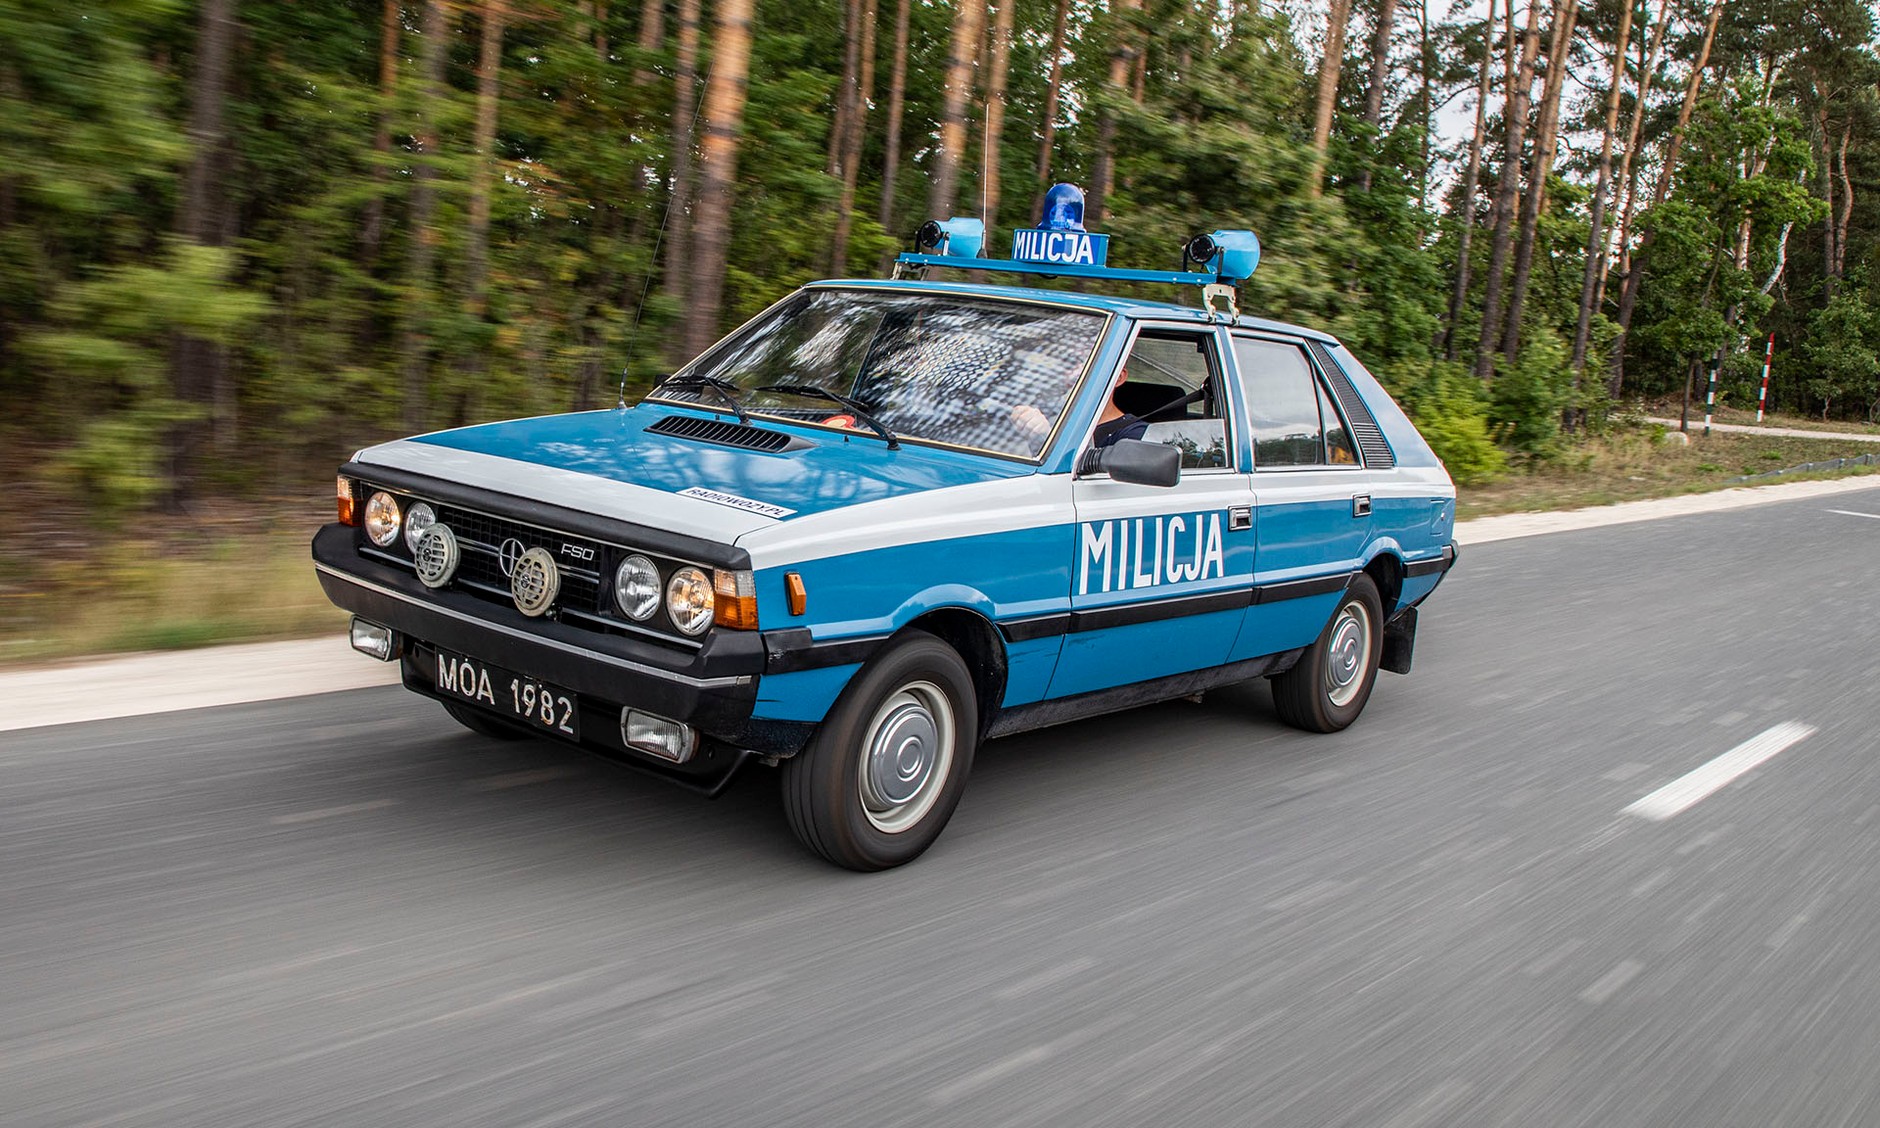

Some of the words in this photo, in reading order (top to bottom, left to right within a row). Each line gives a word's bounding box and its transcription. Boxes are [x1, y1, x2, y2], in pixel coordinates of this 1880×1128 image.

[1013, 231, 1094, 264] MILICJA
[686, 487, 785, 516] RADIOWOZY.PL
[560, 543, 595, 561] FSO
[1079, 513, 1224, 595] MILICJA
[438, 654, 495, 705] MOA
[510, 678, 574, 735] 1982
